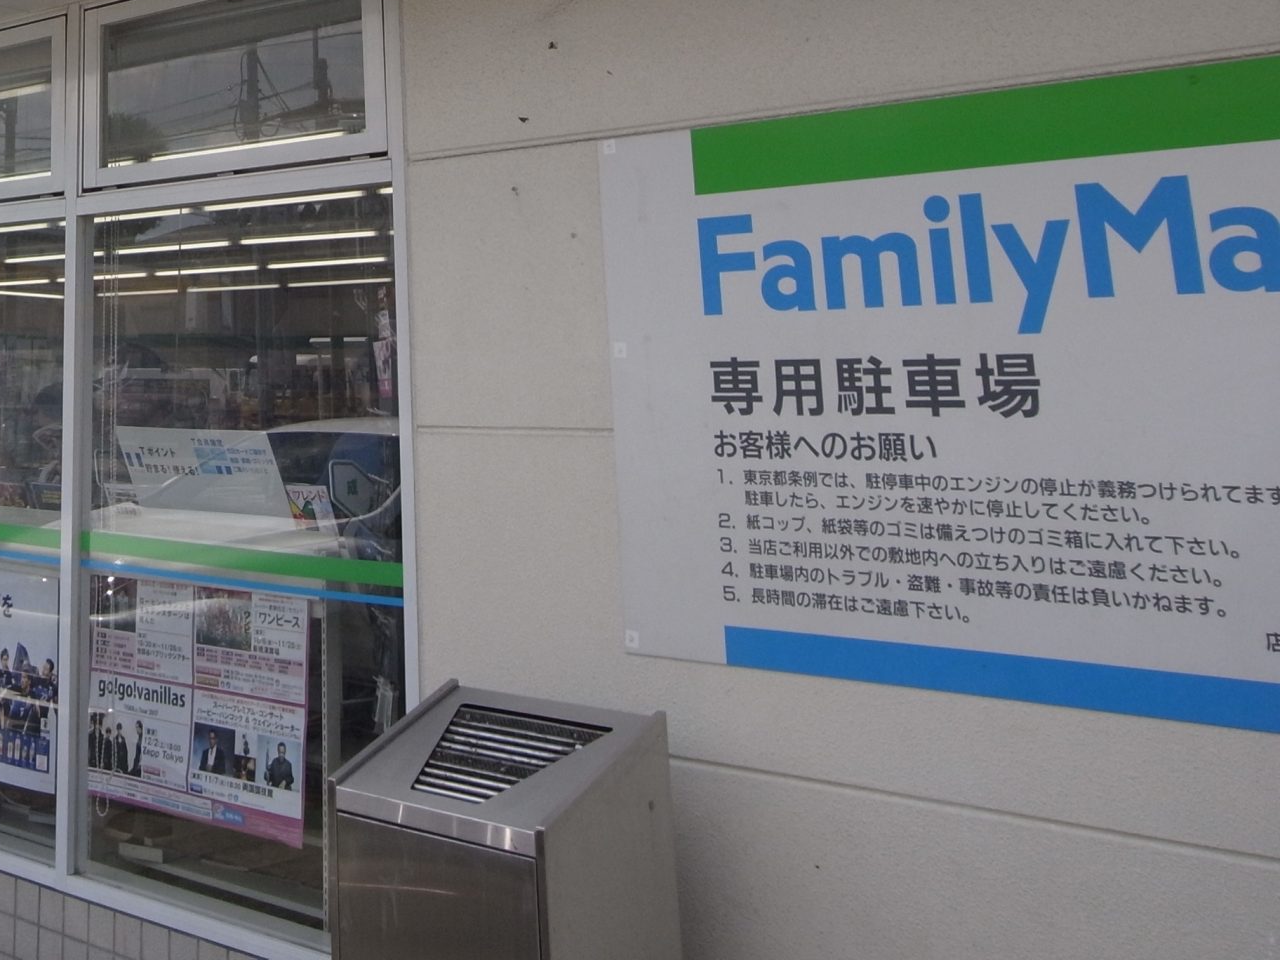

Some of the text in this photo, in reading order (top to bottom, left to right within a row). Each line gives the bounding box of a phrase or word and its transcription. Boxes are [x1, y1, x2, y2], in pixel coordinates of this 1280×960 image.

[709, 352, 1042, 419] 専用駐車場
[713, 429, 939, 462] お客様へのお願い
[98, 677, 186, 708] go!go!vanillas
